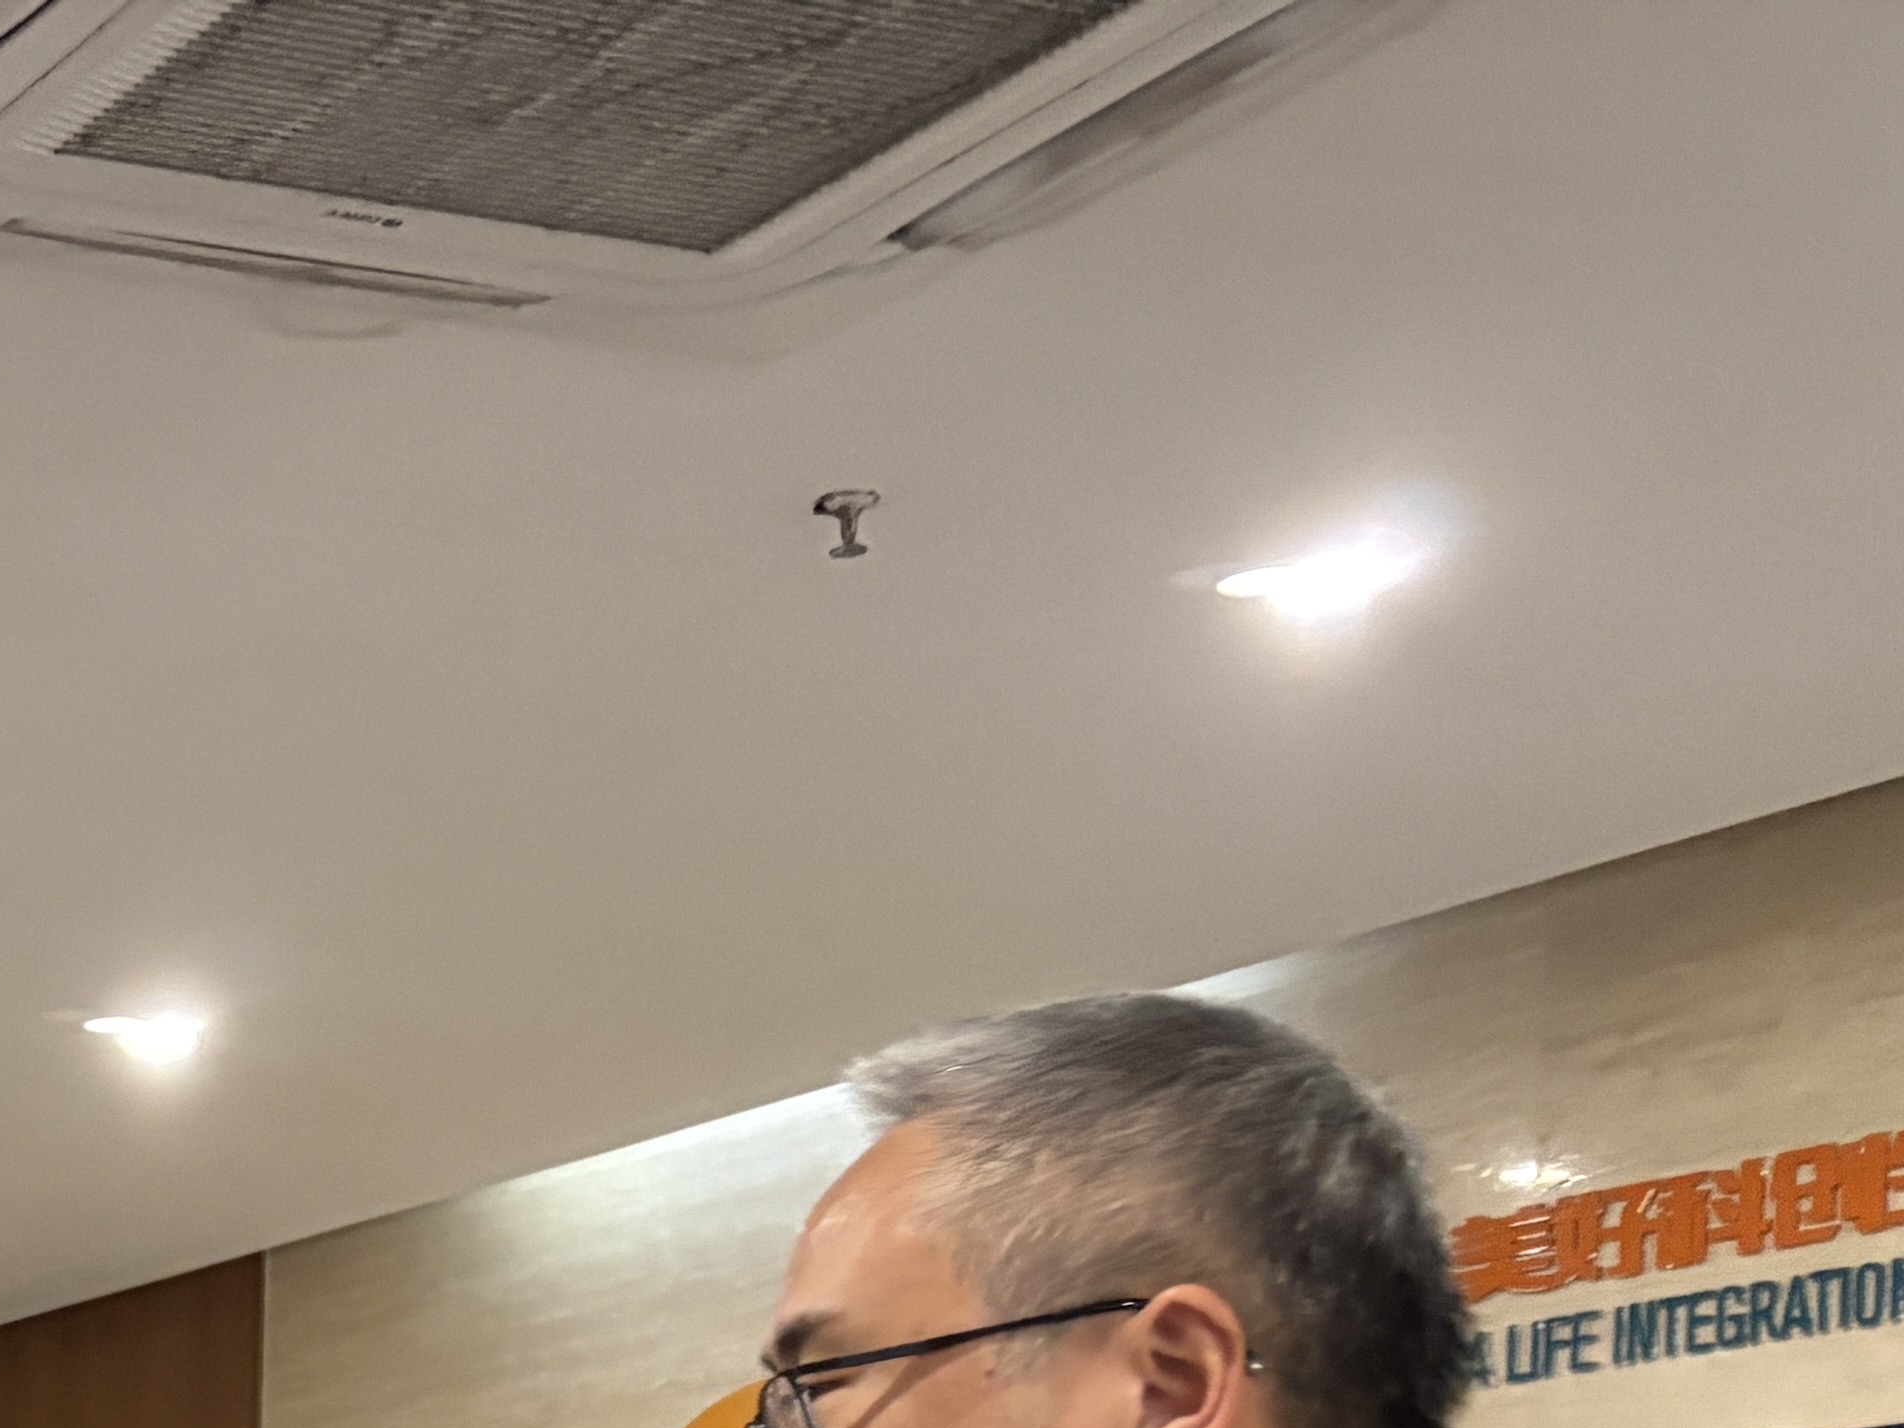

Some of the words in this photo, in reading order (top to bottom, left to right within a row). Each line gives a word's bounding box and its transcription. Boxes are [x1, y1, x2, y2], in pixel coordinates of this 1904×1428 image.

[1448, 1128, 1904, 1304] 美好科创
[1506, 1311, 1604, 1386] LIFE
